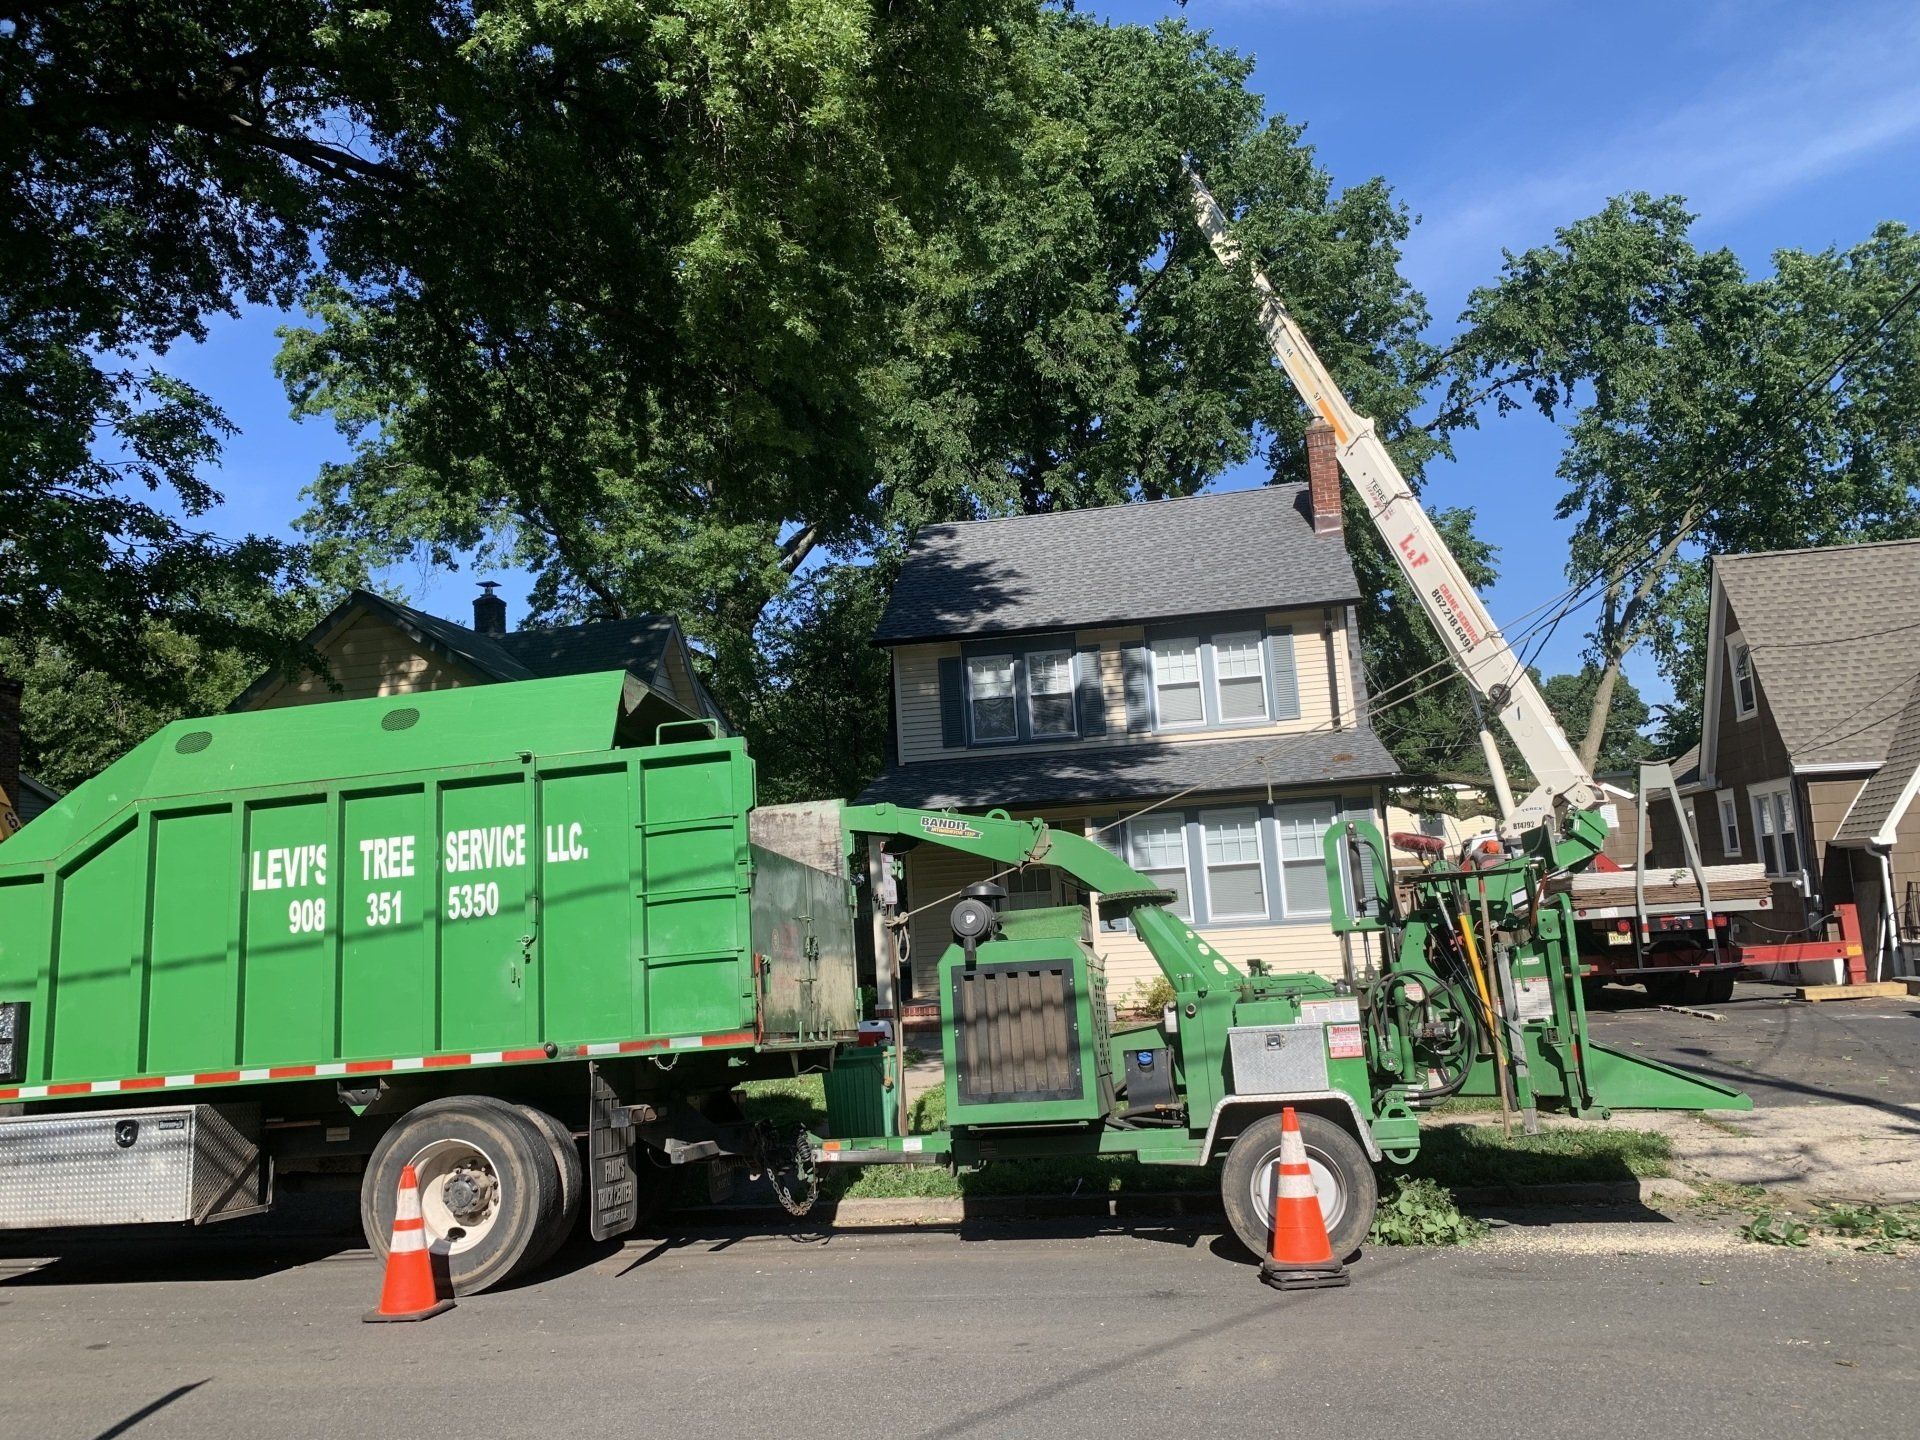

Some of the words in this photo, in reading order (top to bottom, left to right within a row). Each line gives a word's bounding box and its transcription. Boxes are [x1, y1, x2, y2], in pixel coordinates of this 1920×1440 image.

[1370, 478, 1390, 508] TEREX
[1440, 583, 1459, 612] CRANE
[921, 817, 968, 830] BANDIT
[252, 843, 327, 891] LEVI'S
[360, 835, 415, 881] TREE
[446, 824, 526, 873] SERVICE
[546, 822, 589, 863] LLC.
[288, 898, 326, 934] 908
[366, 890, 402, 926] 351
[448, 882, 499, 920] 5350
